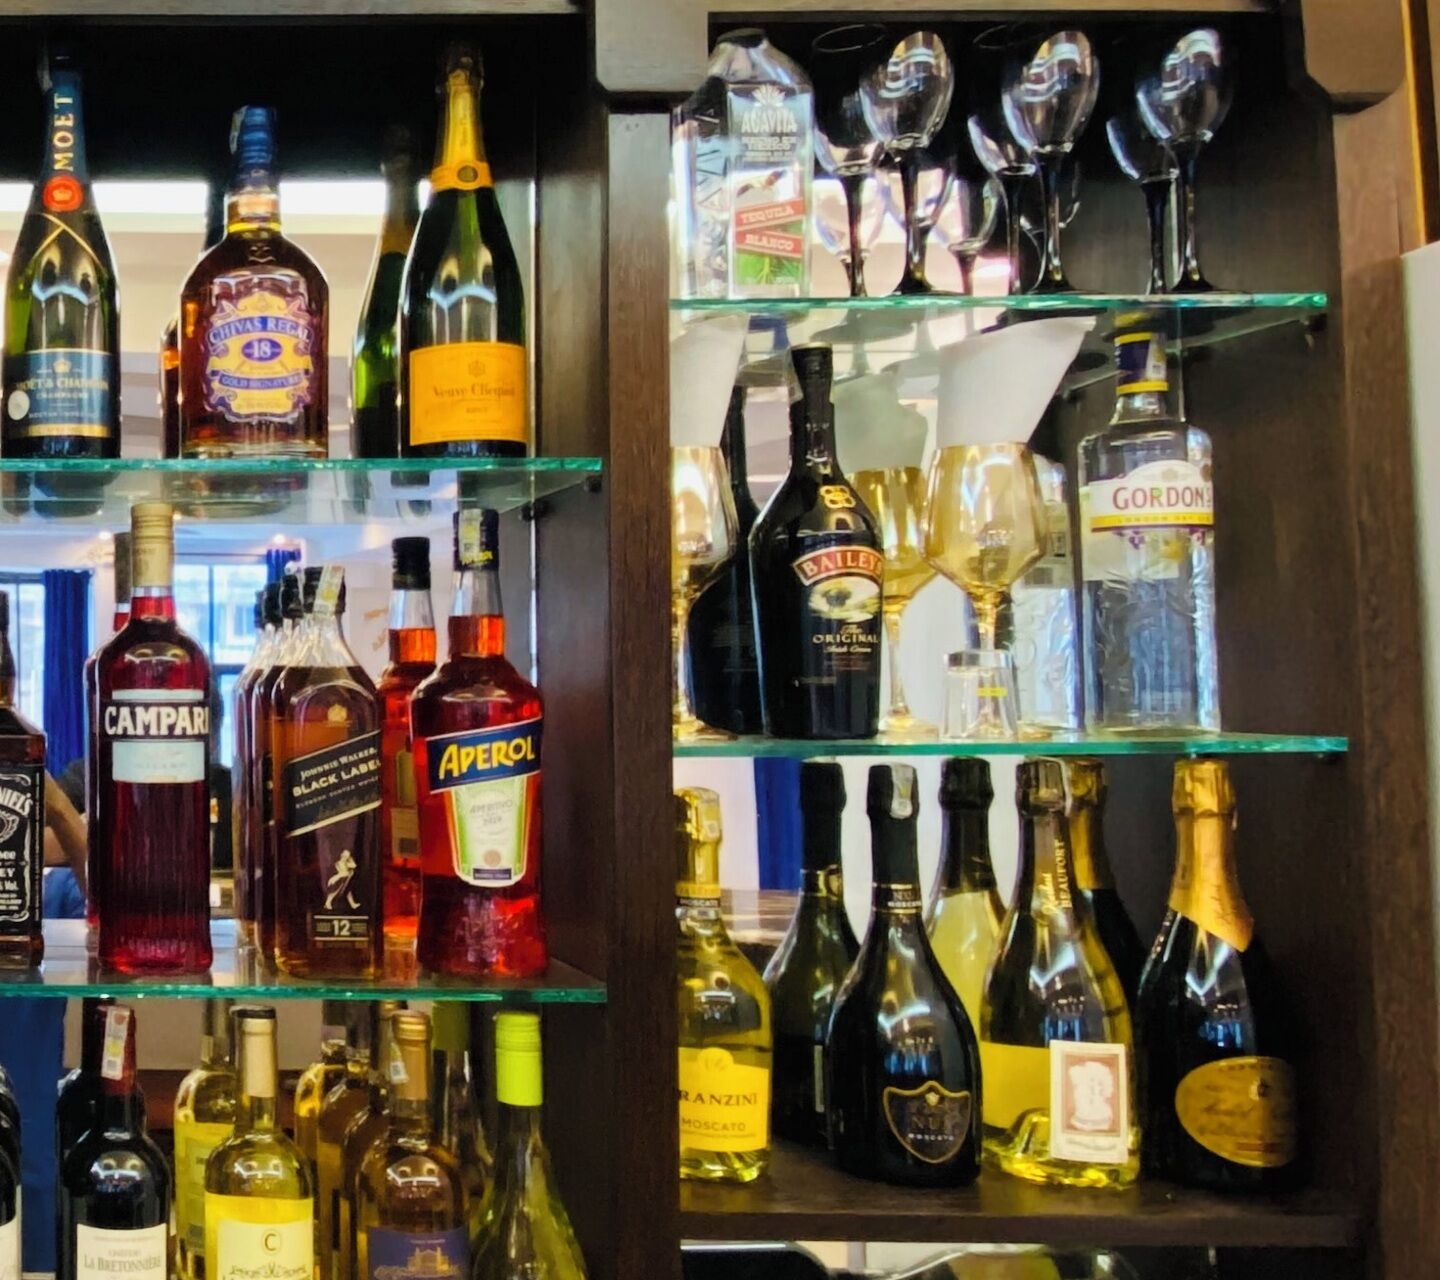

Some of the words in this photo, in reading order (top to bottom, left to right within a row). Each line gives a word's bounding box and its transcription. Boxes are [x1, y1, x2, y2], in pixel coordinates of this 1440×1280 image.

[740, 204, 794, 224] TEQUILA
[745, 232, 794, 251] BLANCO
[209, 317, 260, 344] CHIVAS
[267, 317, 310, 343] REGAL
[252, 339, 272, 359] 18
[801, 550, 883, 577] BAILEYS
[812, 633, 879, 644] ORIGINAL
[104, 705, 210, 736] CAMPARI
[438, 734, 536, 780] APEROL
[292, 772, 339, 797] BLACK
[332, 920, 351, 936] 12
[681, 1117, 747, 1132] MOSCATO
